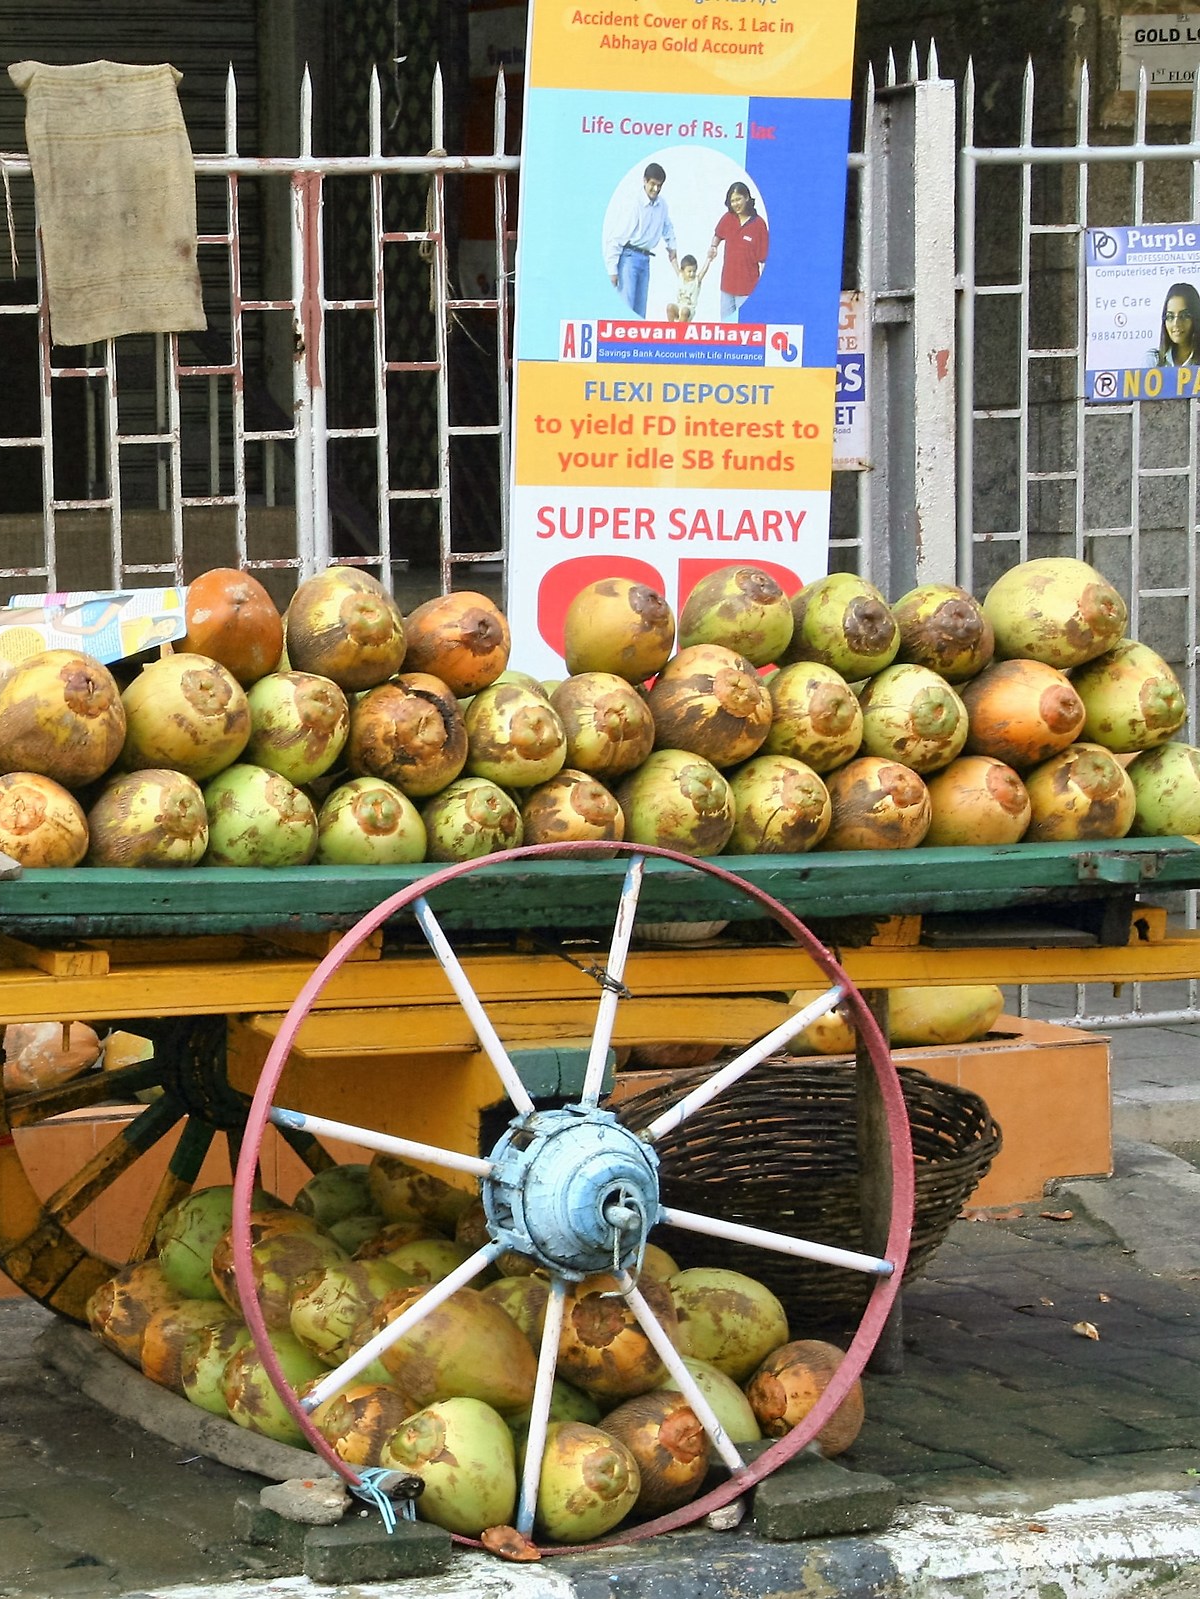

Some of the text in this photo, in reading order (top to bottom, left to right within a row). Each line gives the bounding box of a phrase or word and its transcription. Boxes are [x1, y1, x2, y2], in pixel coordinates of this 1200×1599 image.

[571, 10, 794, 33] Accident Cover of Rs. 1 Lac in
[599, 34, 764, 55] Abhaya Gold Account
[1135, 28, 1180, 42] GOLD
[581, 116, 614, 134] Life
[619, 118, 673, 136] Cover
[677, 119, 698, 137] of
[702, 121, 728, 138] Rs.
[735, 122, 745, 138] 1
[1127, 228, 1196, 251] Purple
[1128, 253, 1186, 263] PROFESSIONAL
[1095, 268, 1157, 278] Computerised
[1160, 266, 1175, 277] Eye
[1095, 297, 1151, 311] Eye Care
[600, 323, 763, 345] Jeevan Abhaya
[1091, 330, 1153, 341] 9884701200
[599, 348, 763, 361] Savings Bank Account with Life Insurance
[584, 381, 774, 405] FLEXI DEPOSIT
[1123, 369, 1163, 398] NO
[535, 413, 819, 439] to yield FD interest to
[558, 448, 795, 472] your idle SB funds
[536, 506, 807, 542] SUPER SALARY
